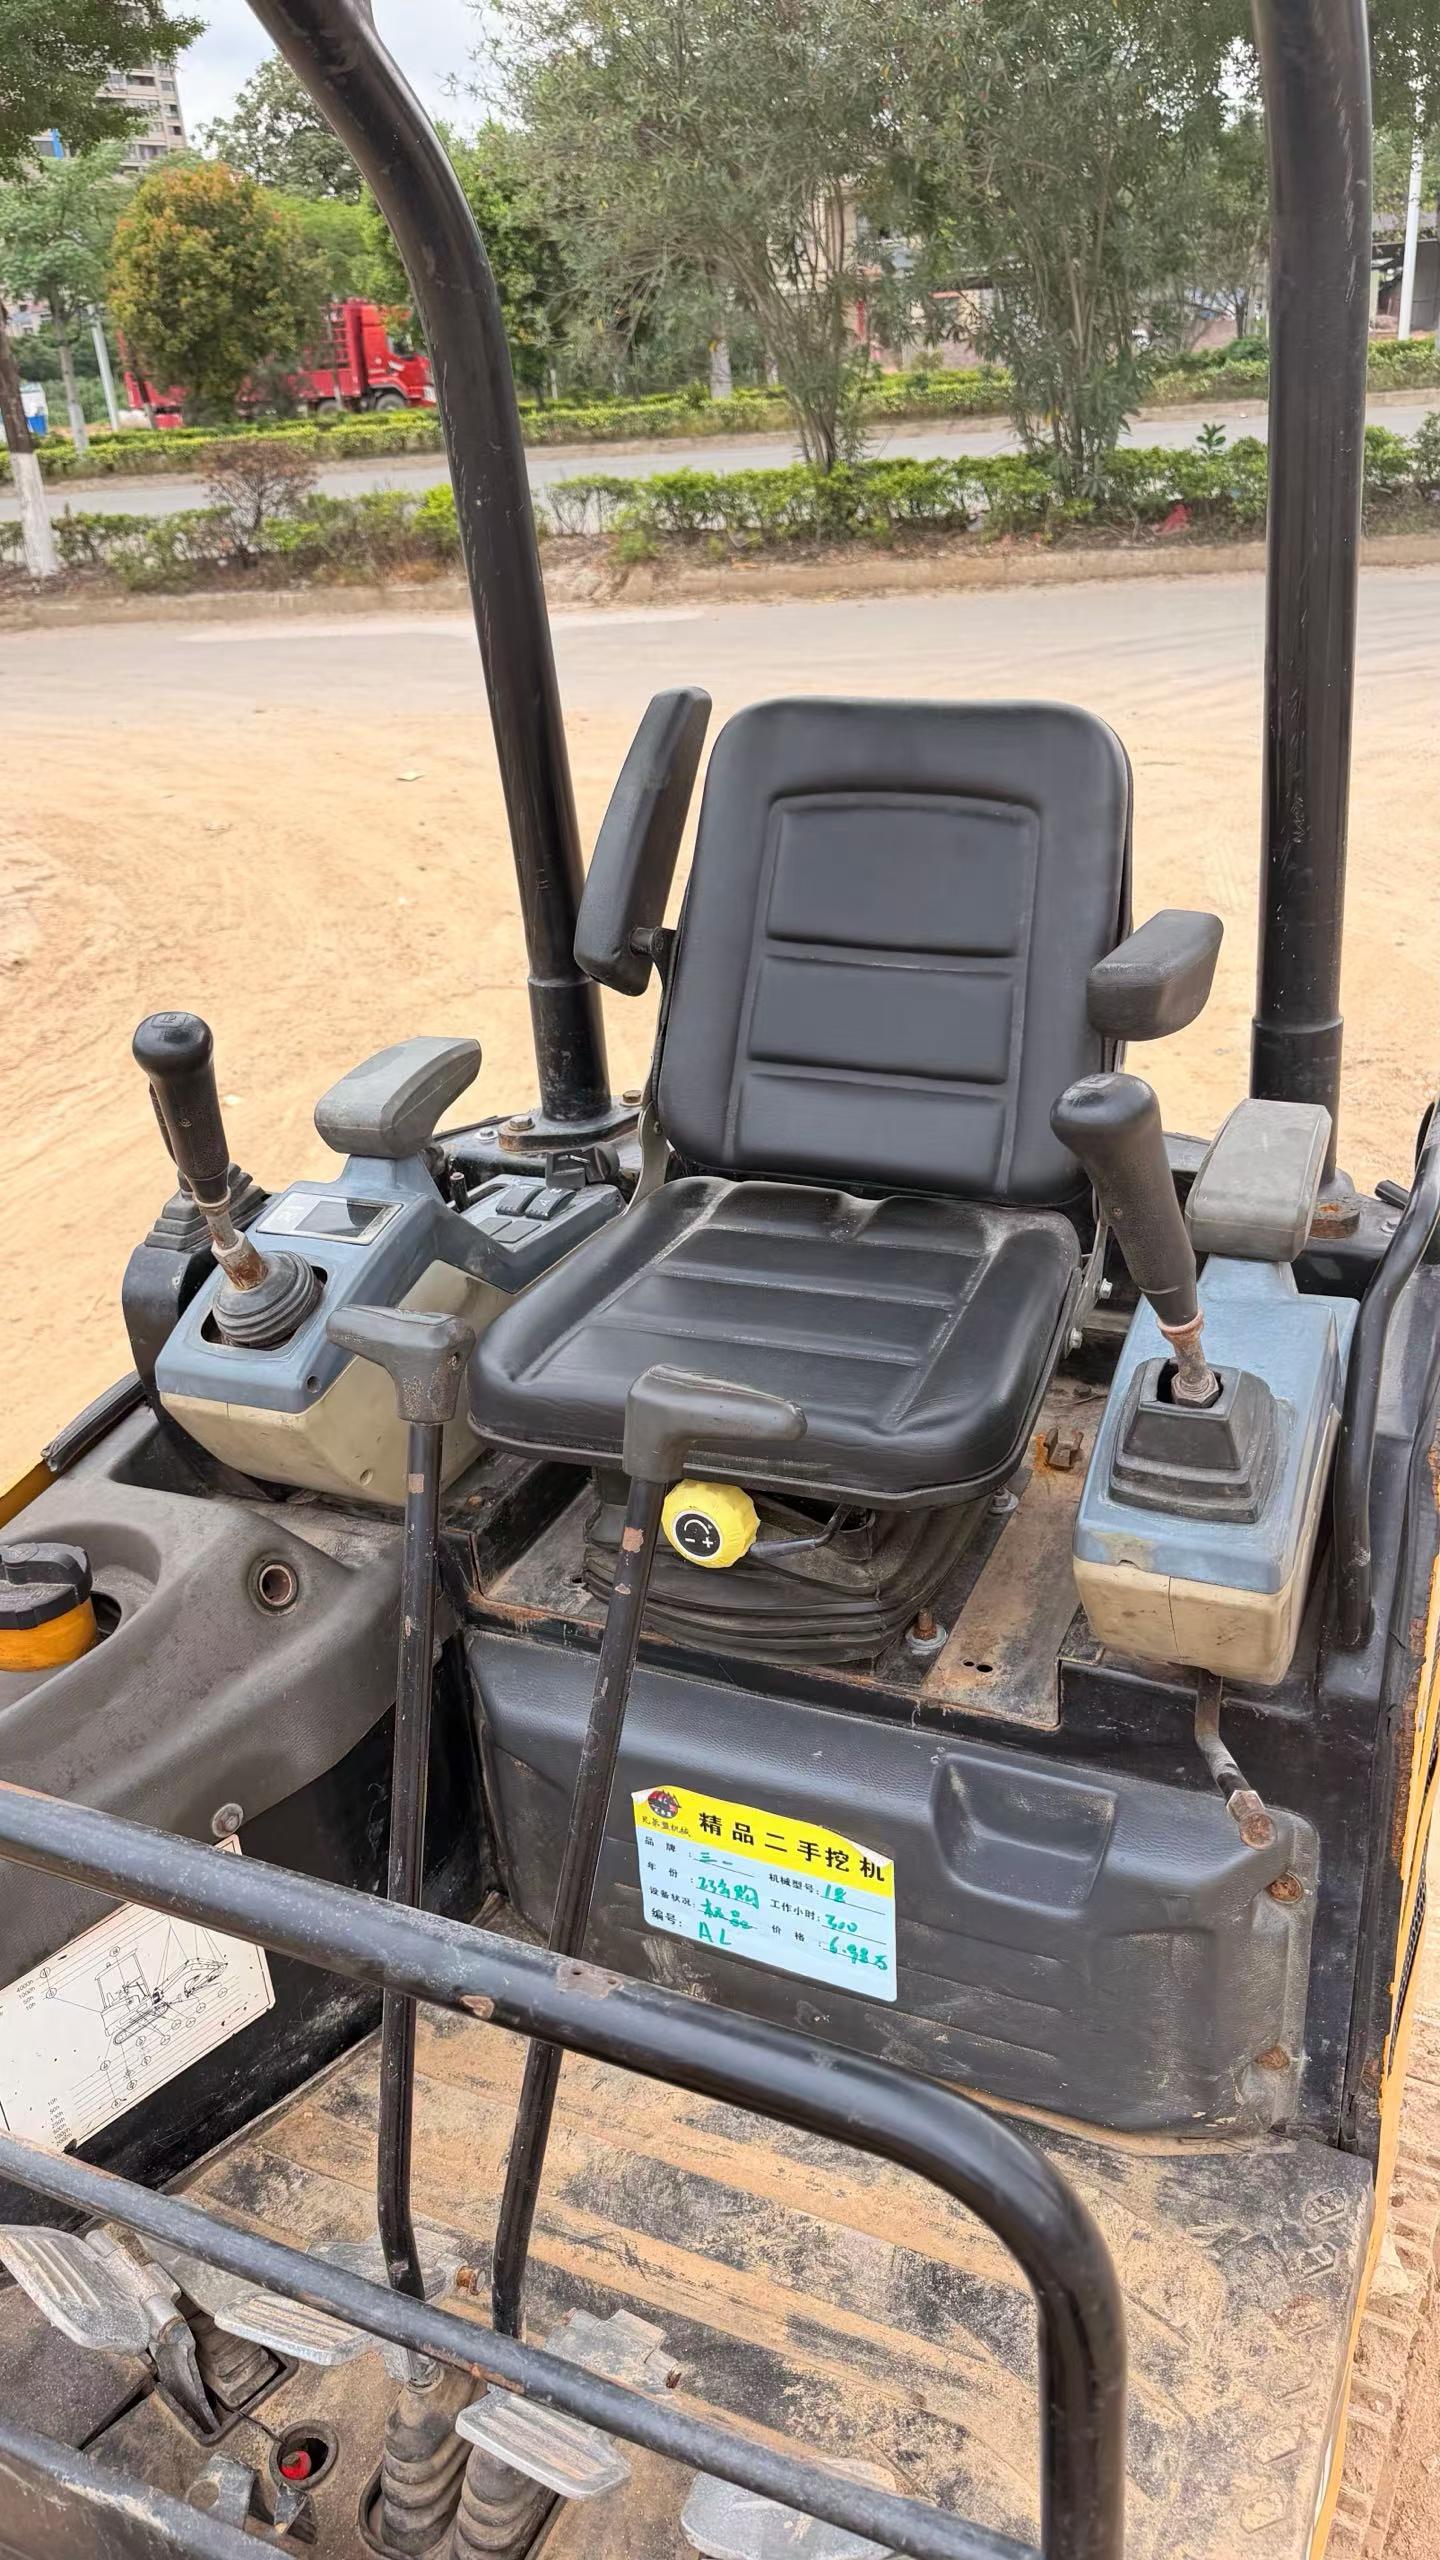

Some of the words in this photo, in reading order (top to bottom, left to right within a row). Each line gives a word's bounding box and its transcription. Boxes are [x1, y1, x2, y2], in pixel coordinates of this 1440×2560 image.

[699, 1812, 885, 1882] 精品二手挖机
